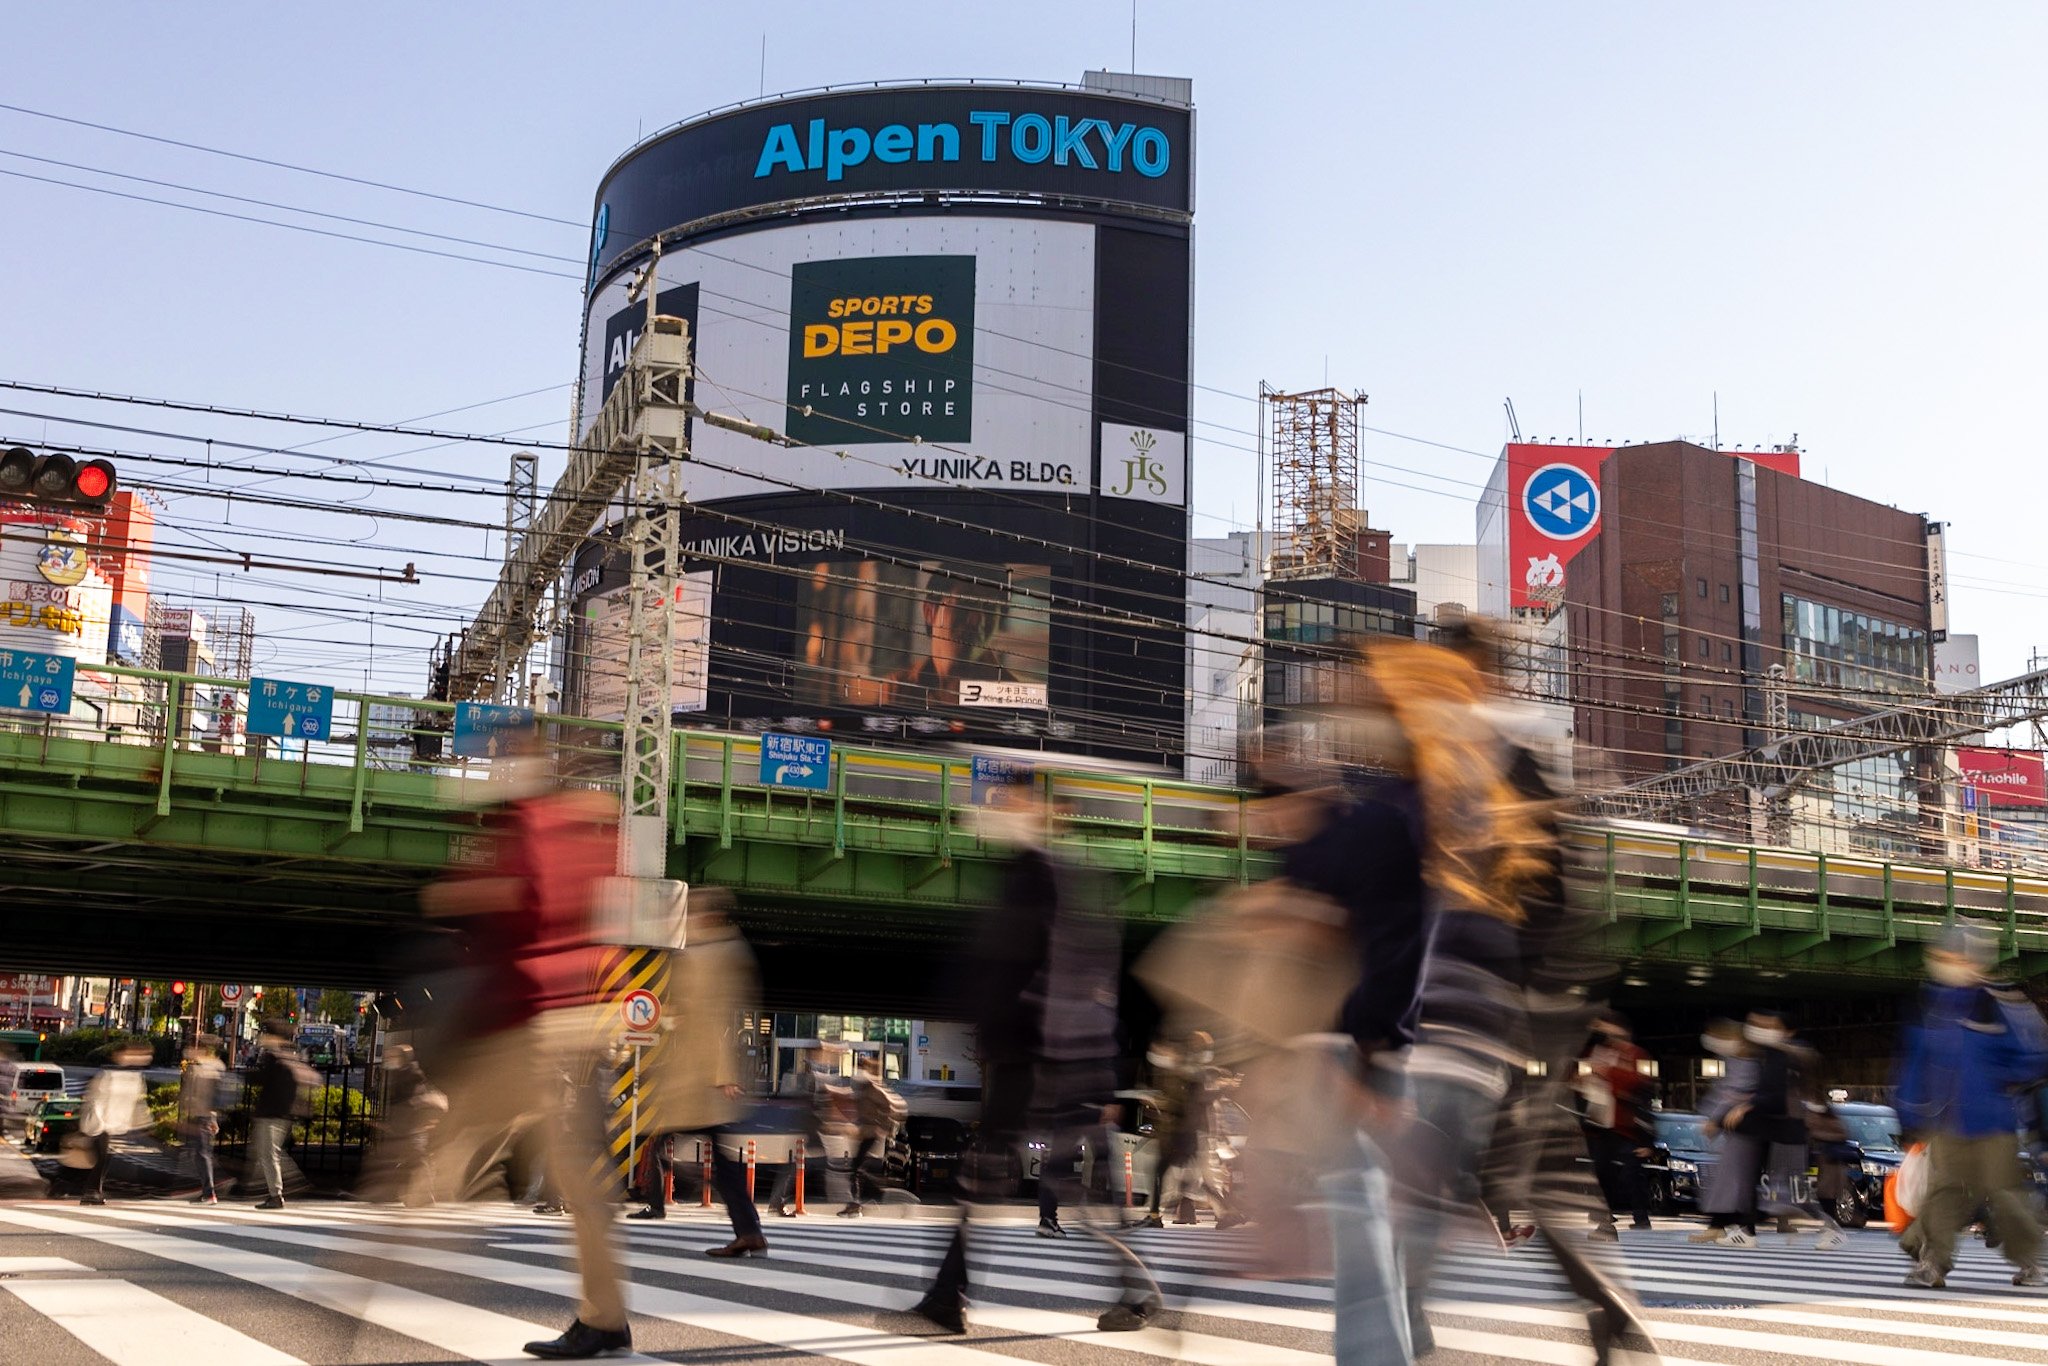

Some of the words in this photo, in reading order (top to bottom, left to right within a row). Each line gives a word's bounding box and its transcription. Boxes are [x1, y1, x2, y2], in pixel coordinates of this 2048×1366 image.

[754, 118, 960, 182] Alpen
[970, 111, 1170, 178] TOKYO
[828, 295, 933, 318] SPORTS
[803, 318, 957, 358] DEPO
[801, 379, 955, 398] FLAGSHIP
[857, 402, 955, 417] STORE
[902, 458, 1003, 480] YUNIKA
[1010, 461, 1077, 485] BLDG.
[679, 535, 756, 562] YUNIKA
[761, 528, 844, 553] VISION
[3, 669, 52, 685] Ichigaya
[43, 694, 57, 704] 302
[268, 700, 313, 713] Ichigaya
[305, 721, 318, 731] 302
[767, 736, 826, 755] 新宿駅東口
[768, 751, 798, 762] Shinjuku
